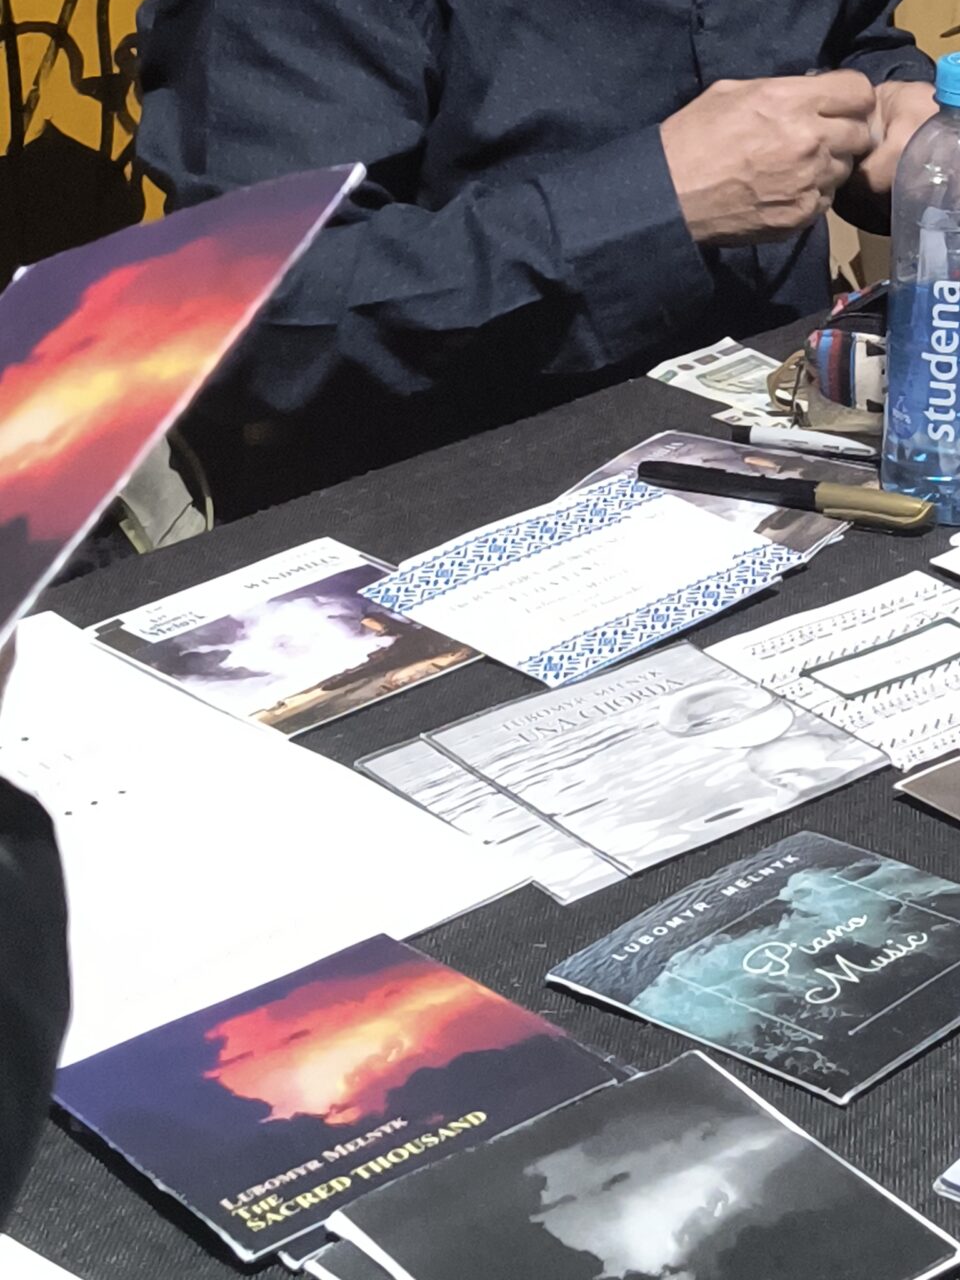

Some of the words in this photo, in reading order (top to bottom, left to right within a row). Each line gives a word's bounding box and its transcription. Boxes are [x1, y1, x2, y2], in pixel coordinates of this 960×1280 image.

[611, 900, 710, 962] LUBOMYR
[721, 852, 800, 896] MELNYK
[742, 914, 868, 978] Piano
[806, 929, 928, 1005] Music
[219, 1157, 324, 1211] LUBOMYR
[321, 1117, 408, 1163] MELNYK
[246, 1175, 352, 1232] SACRED
[350, 1110, 488, 1181] THOUSAND
[232, 1193, 284, 1223] THE
